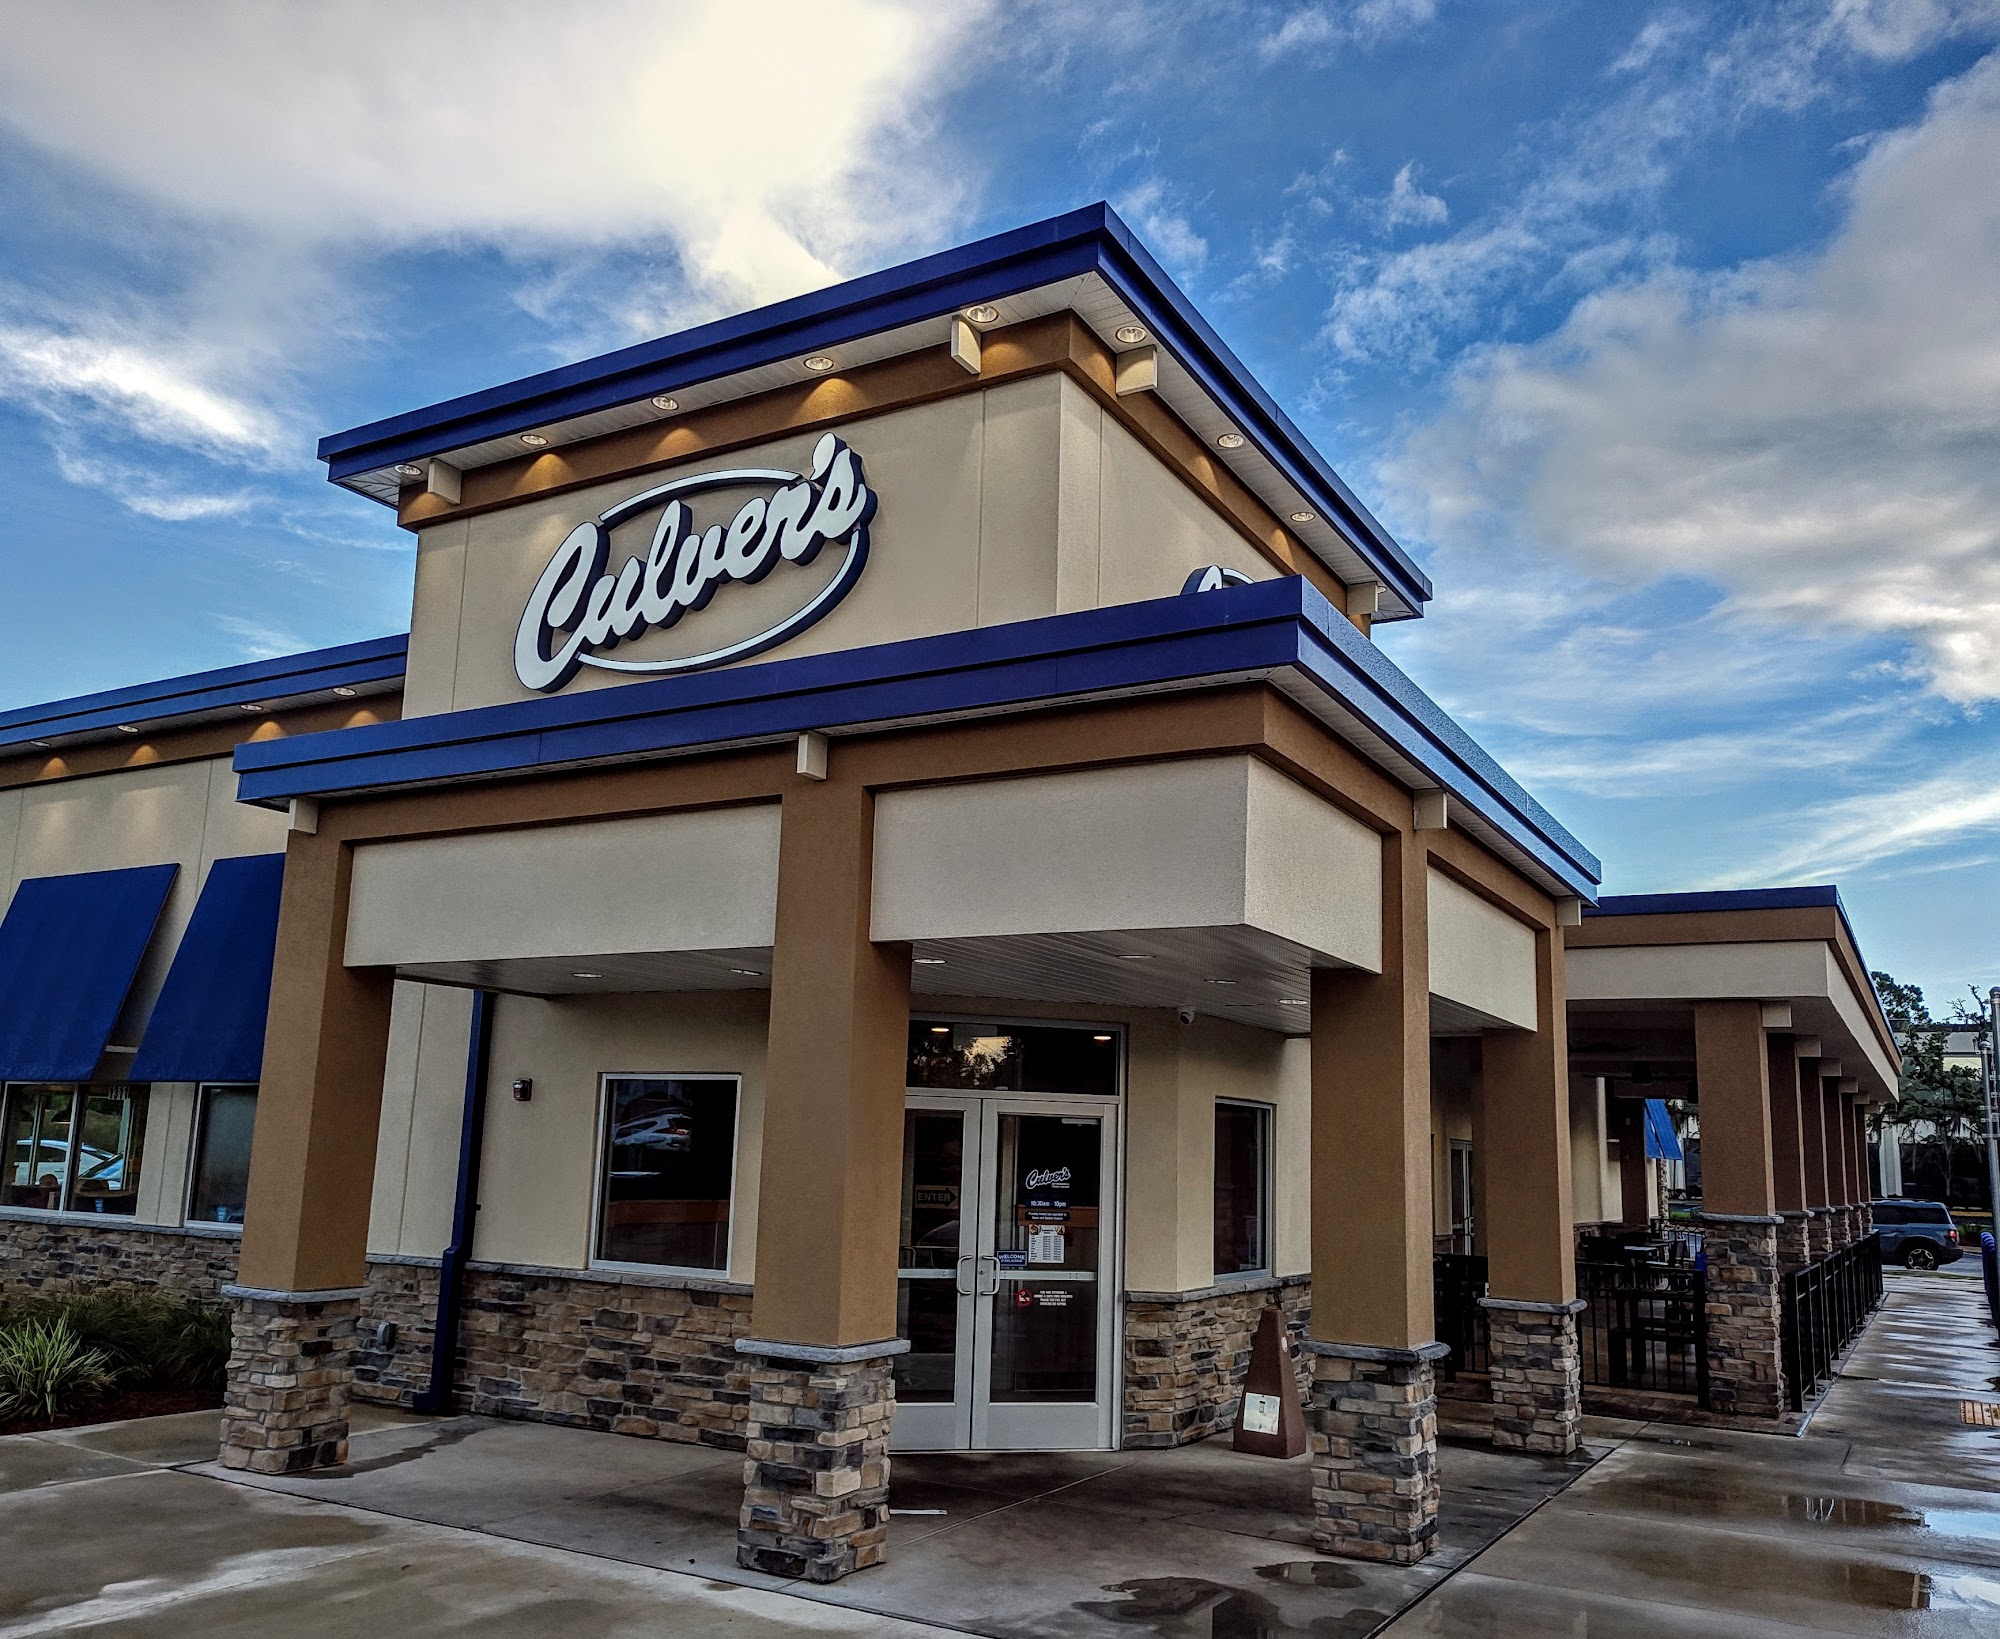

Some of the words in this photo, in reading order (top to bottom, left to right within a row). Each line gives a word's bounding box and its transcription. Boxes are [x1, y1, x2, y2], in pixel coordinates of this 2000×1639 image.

[514, 432, 873, 691] Culver's
[1025, 1166, 1071, 1189] Culver's
[917, 1192, 951, 1202] ENTER
